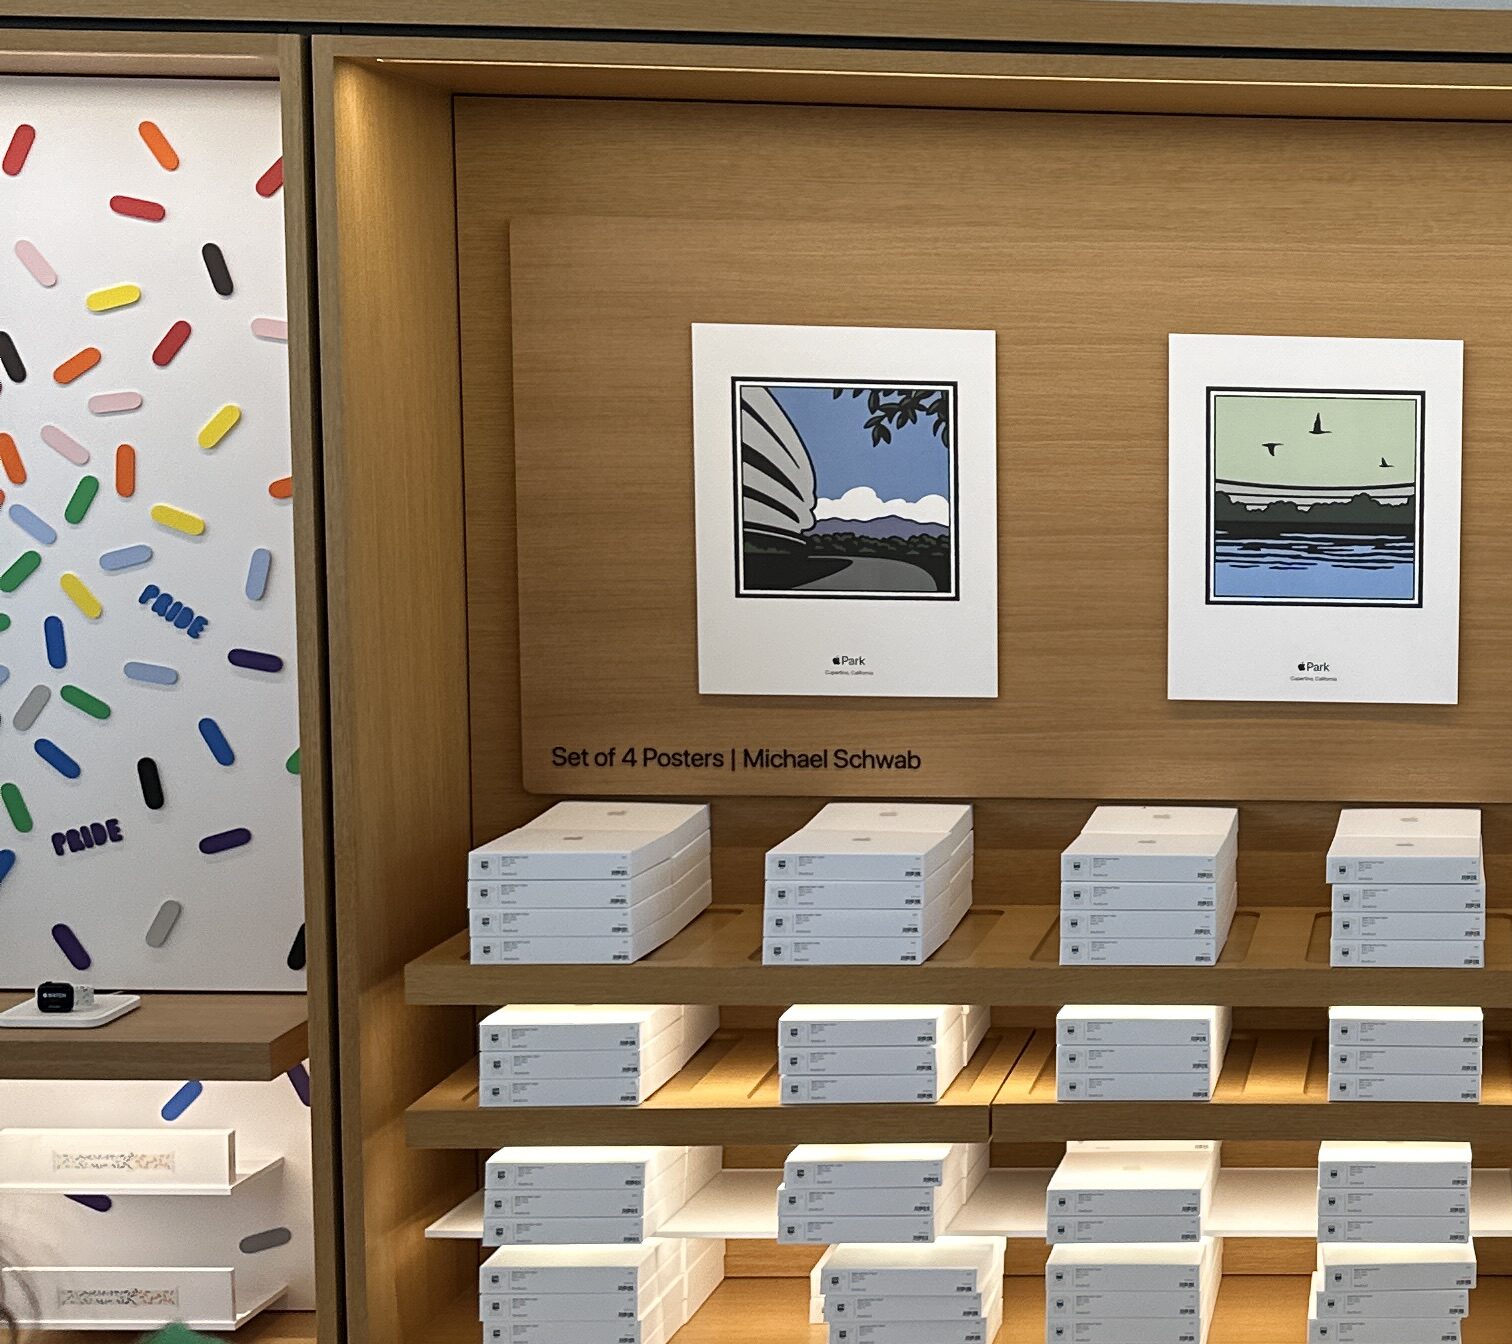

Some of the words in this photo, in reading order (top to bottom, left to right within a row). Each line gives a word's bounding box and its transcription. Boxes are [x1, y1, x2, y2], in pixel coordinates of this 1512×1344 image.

[138, 584, 209, 640] PRIDE
[841, 655, 866, 666] Park
[1306, 661, 1331, 672] Park
[552, 746, 590, 767] Set
[594, 747, 617, 767] of
[621, 747, 638, 768] 4
[643, 747, 725, 768] Posters
[743, 748, 828, 769] Michael
[833, 748, 922, 770] Schwab
[51, 818, 124, 856] PRIDE
